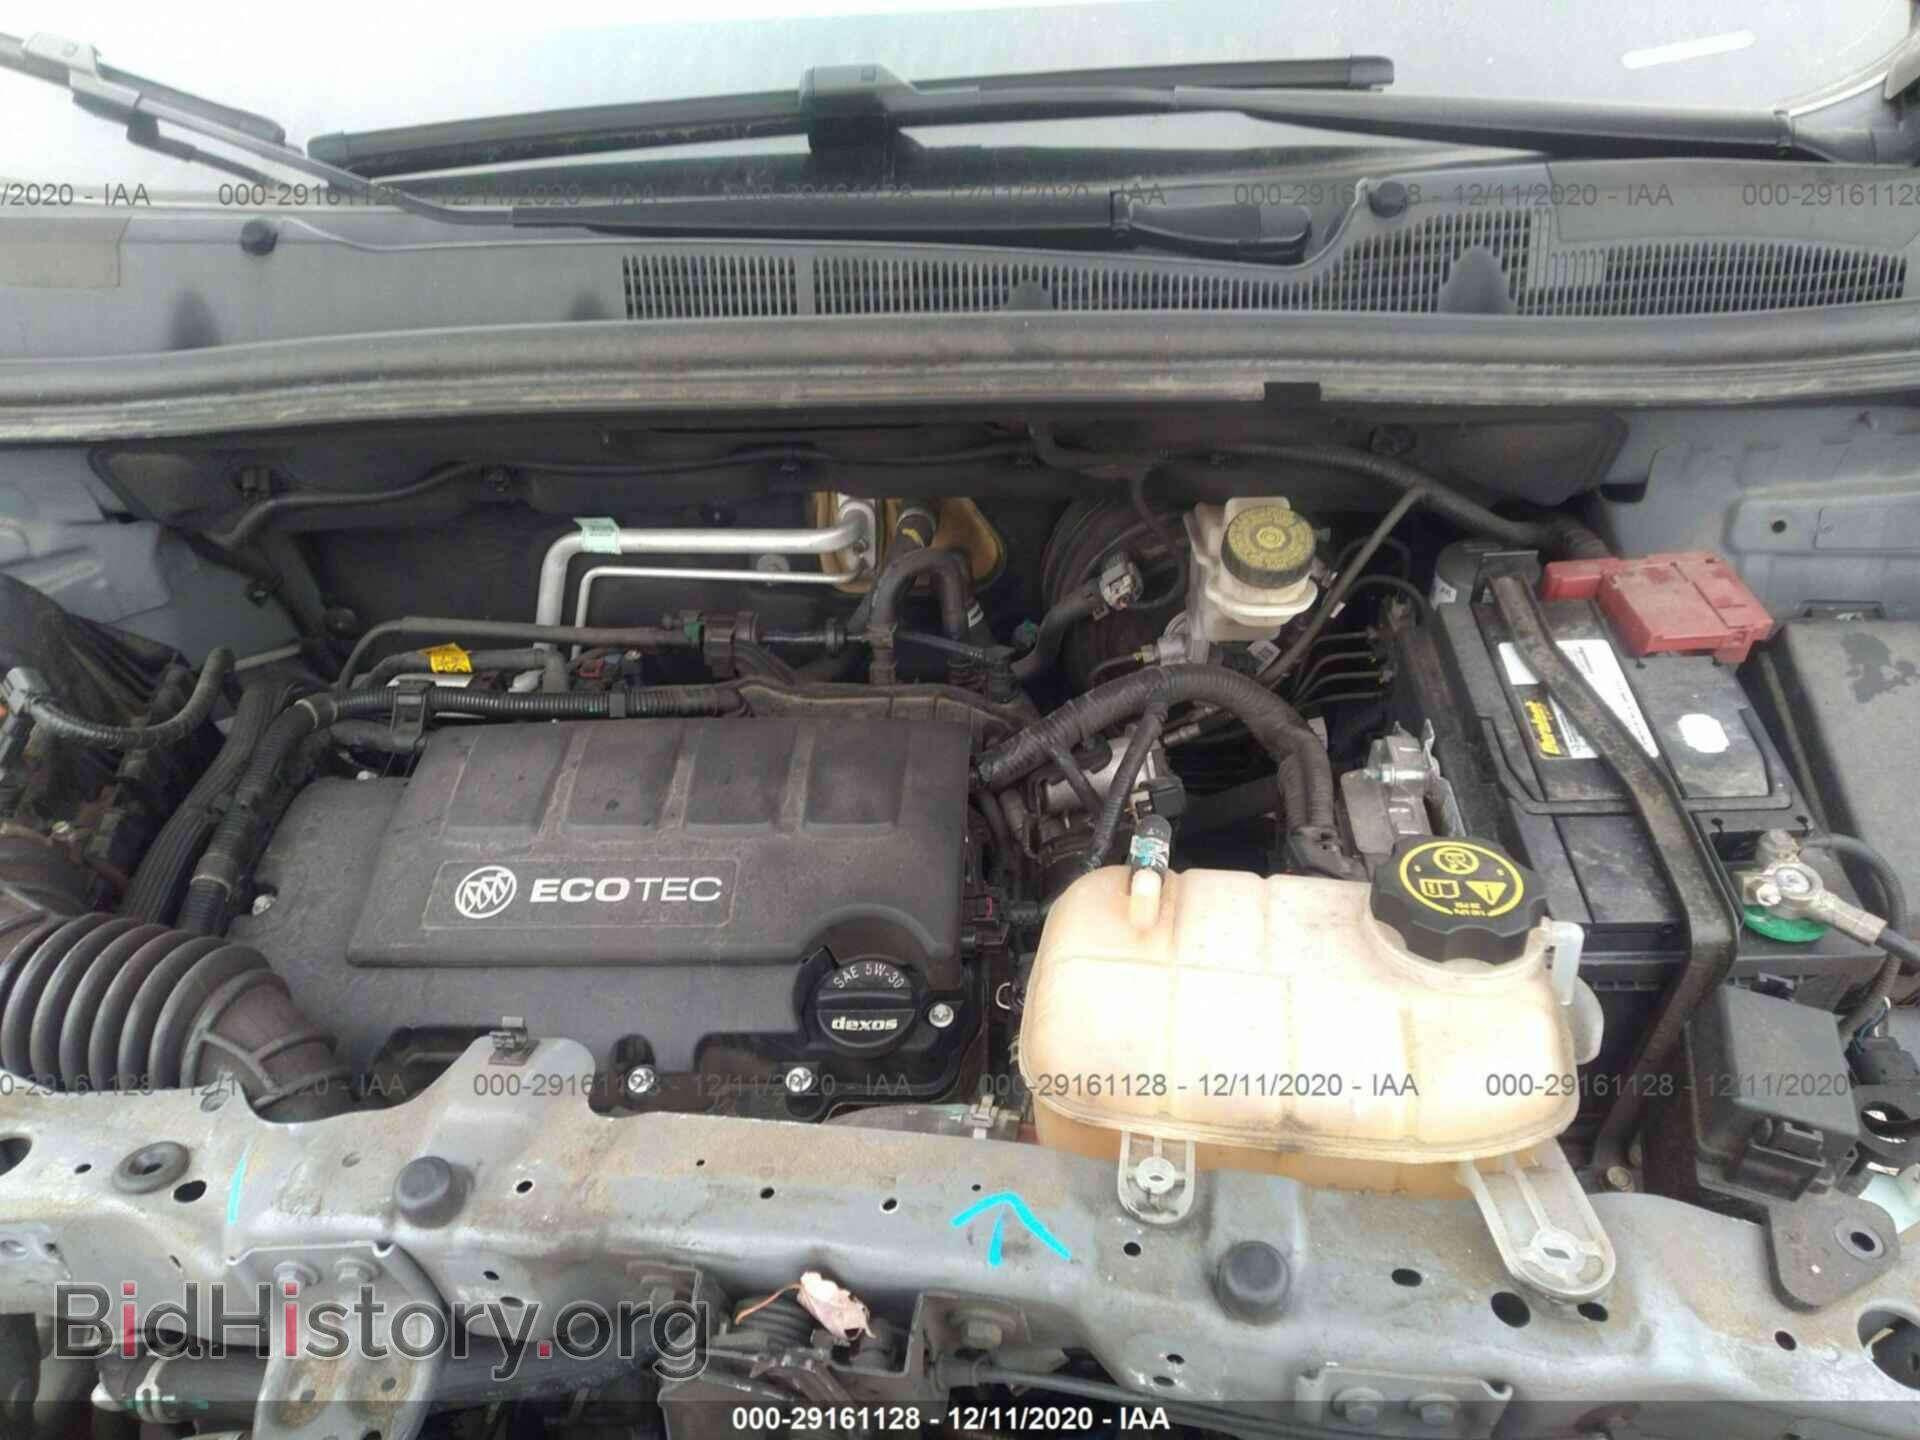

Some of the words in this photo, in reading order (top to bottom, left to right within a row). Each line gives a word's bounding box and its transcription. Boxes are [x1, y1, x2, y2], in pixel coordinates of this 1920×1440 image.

[529, 876, 723, 903] ECOTEC
[833, 965, 859, 989] SAE
[864, 963, 905, 989] 5W-30
[831, 1016, 898, 1031] dexos
